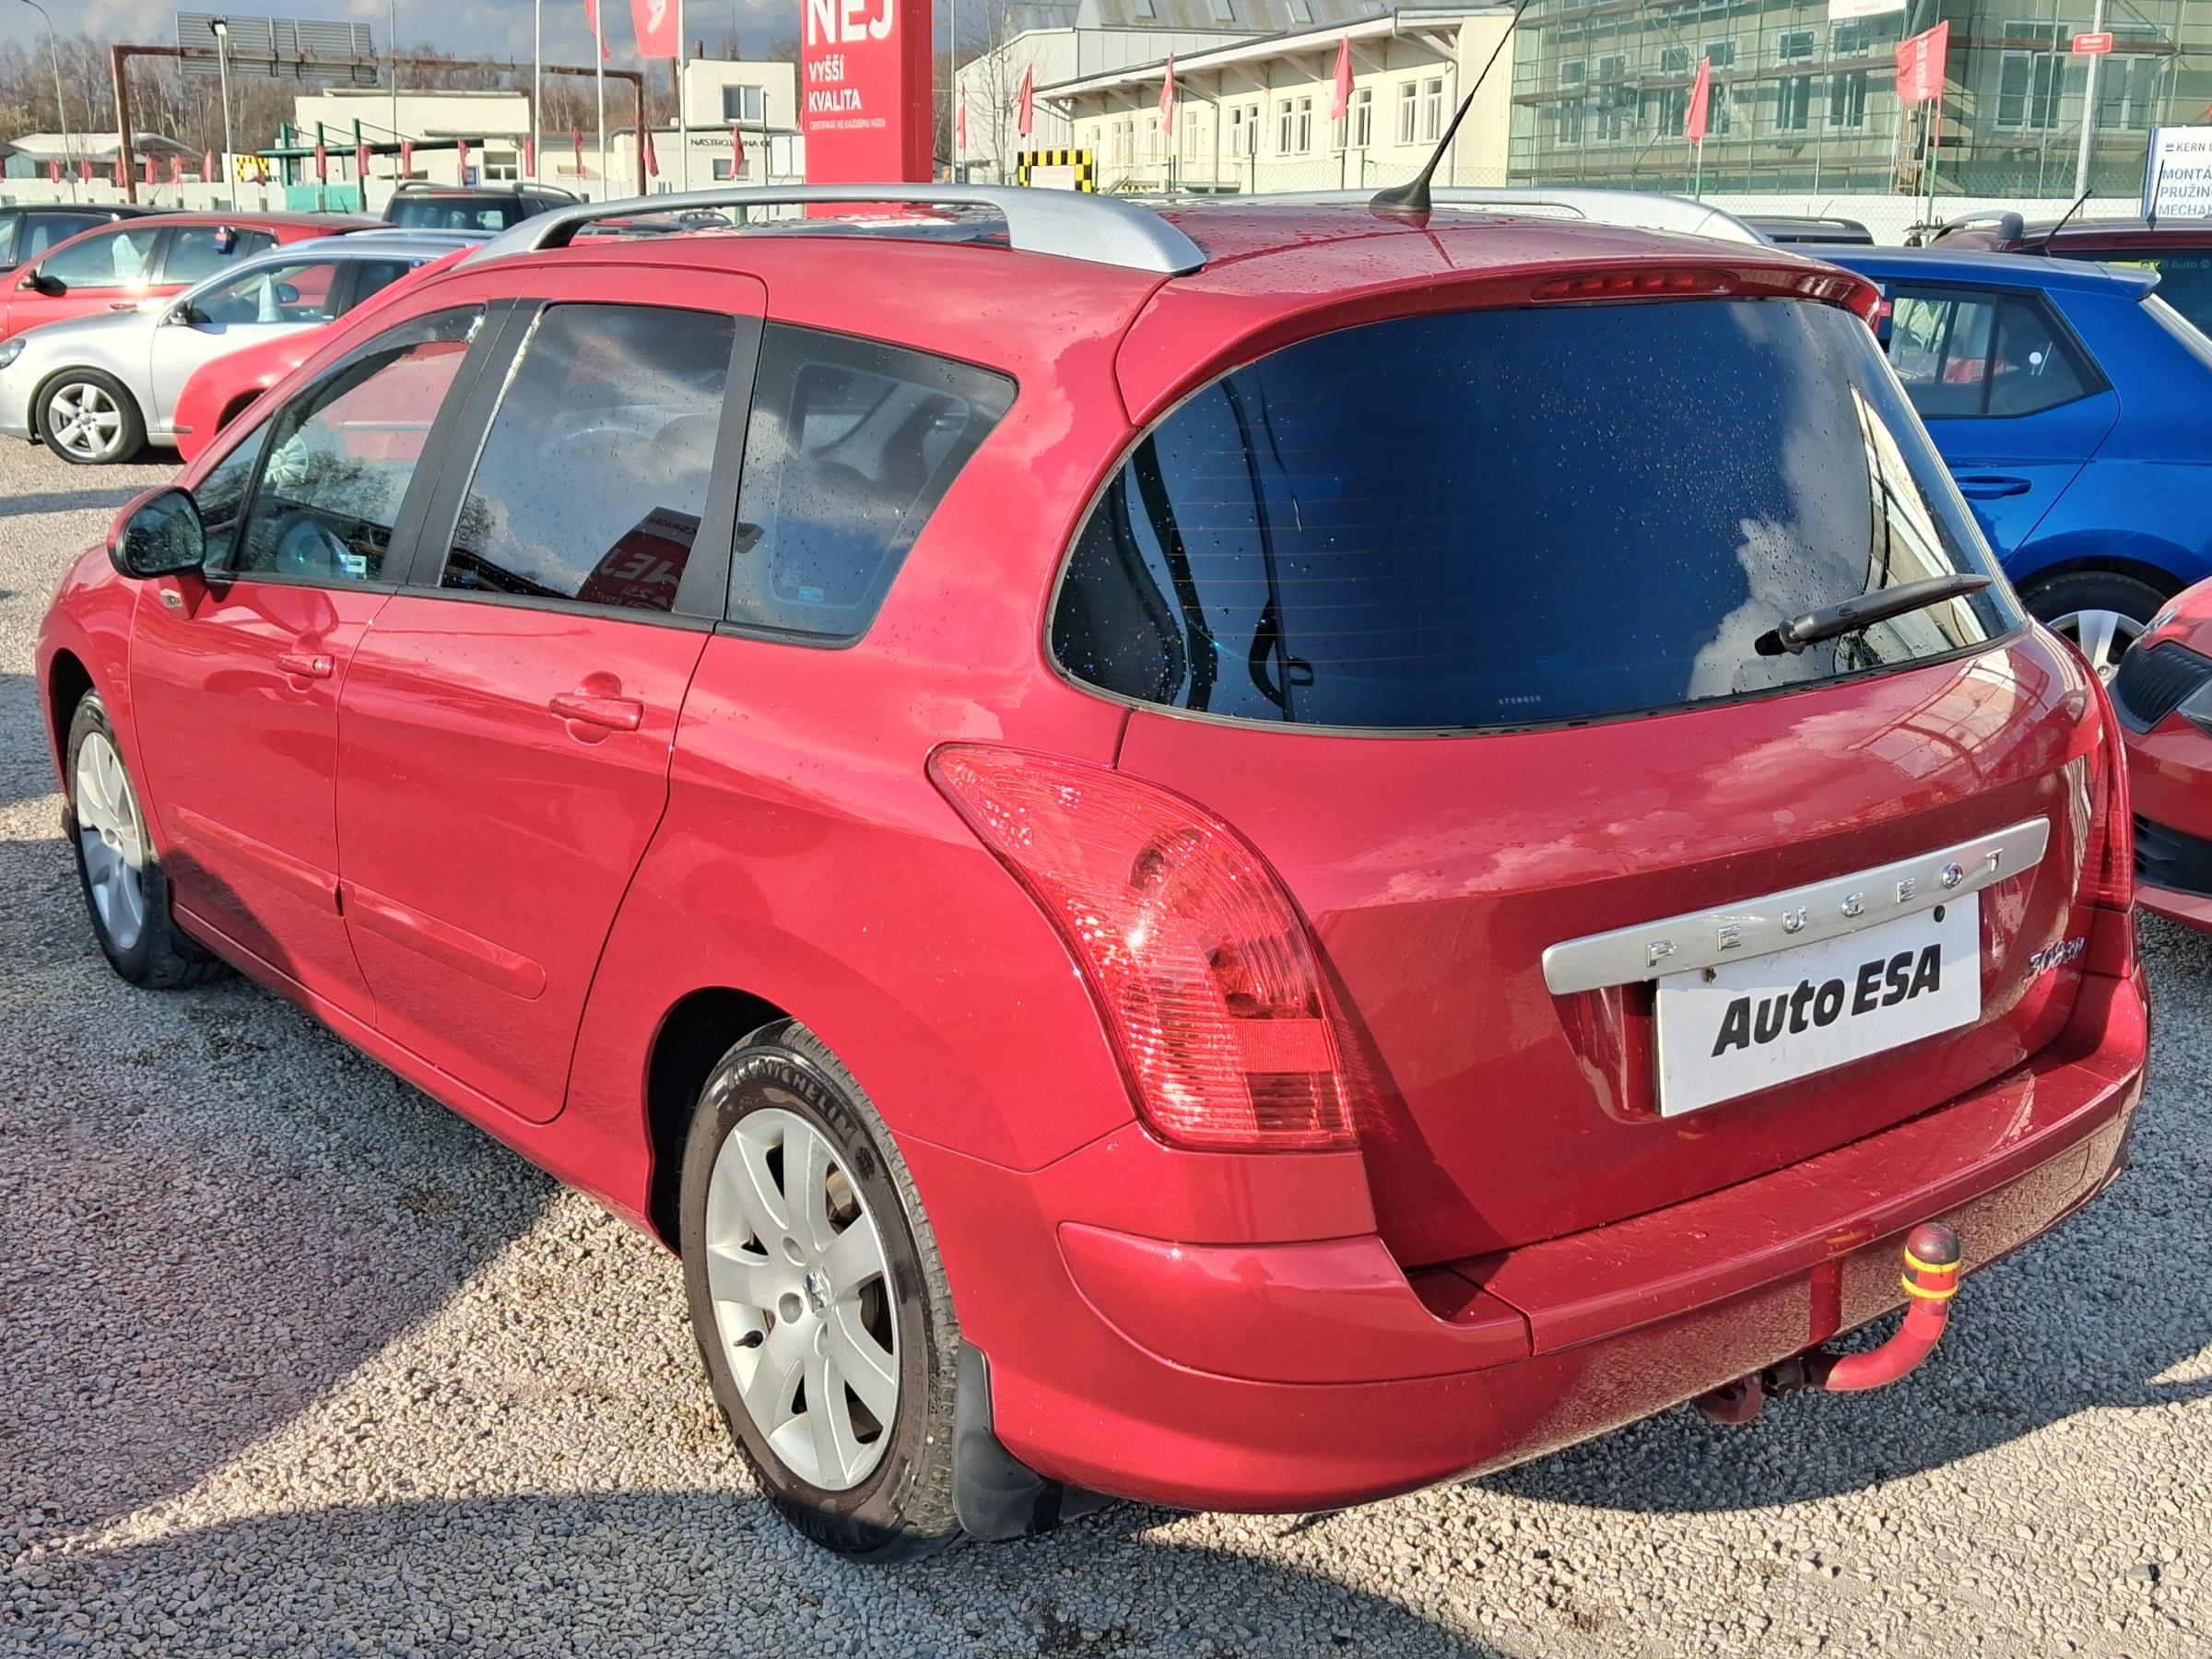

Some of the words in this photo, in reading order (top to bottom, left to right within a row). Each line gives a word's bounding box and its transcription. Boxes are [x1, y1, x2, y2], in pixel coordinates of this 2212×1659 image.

[806, 0, 894, 46] NEJ
[807, 53, 845, 83] VYŠŠÍ
[807, 88, 863, 112] KVALITA
[2176, 142, 2206, 152] KERN
[2159, 185, 2212, 198] PRUŽIN
[1645, 847, 2004, 968] PEUGEOT
[1711, 979, 1844, 1057] Auto
[1851, 943, 1942, 1017] ESA
[756, 1058, 858, 1142] MICHELIN
